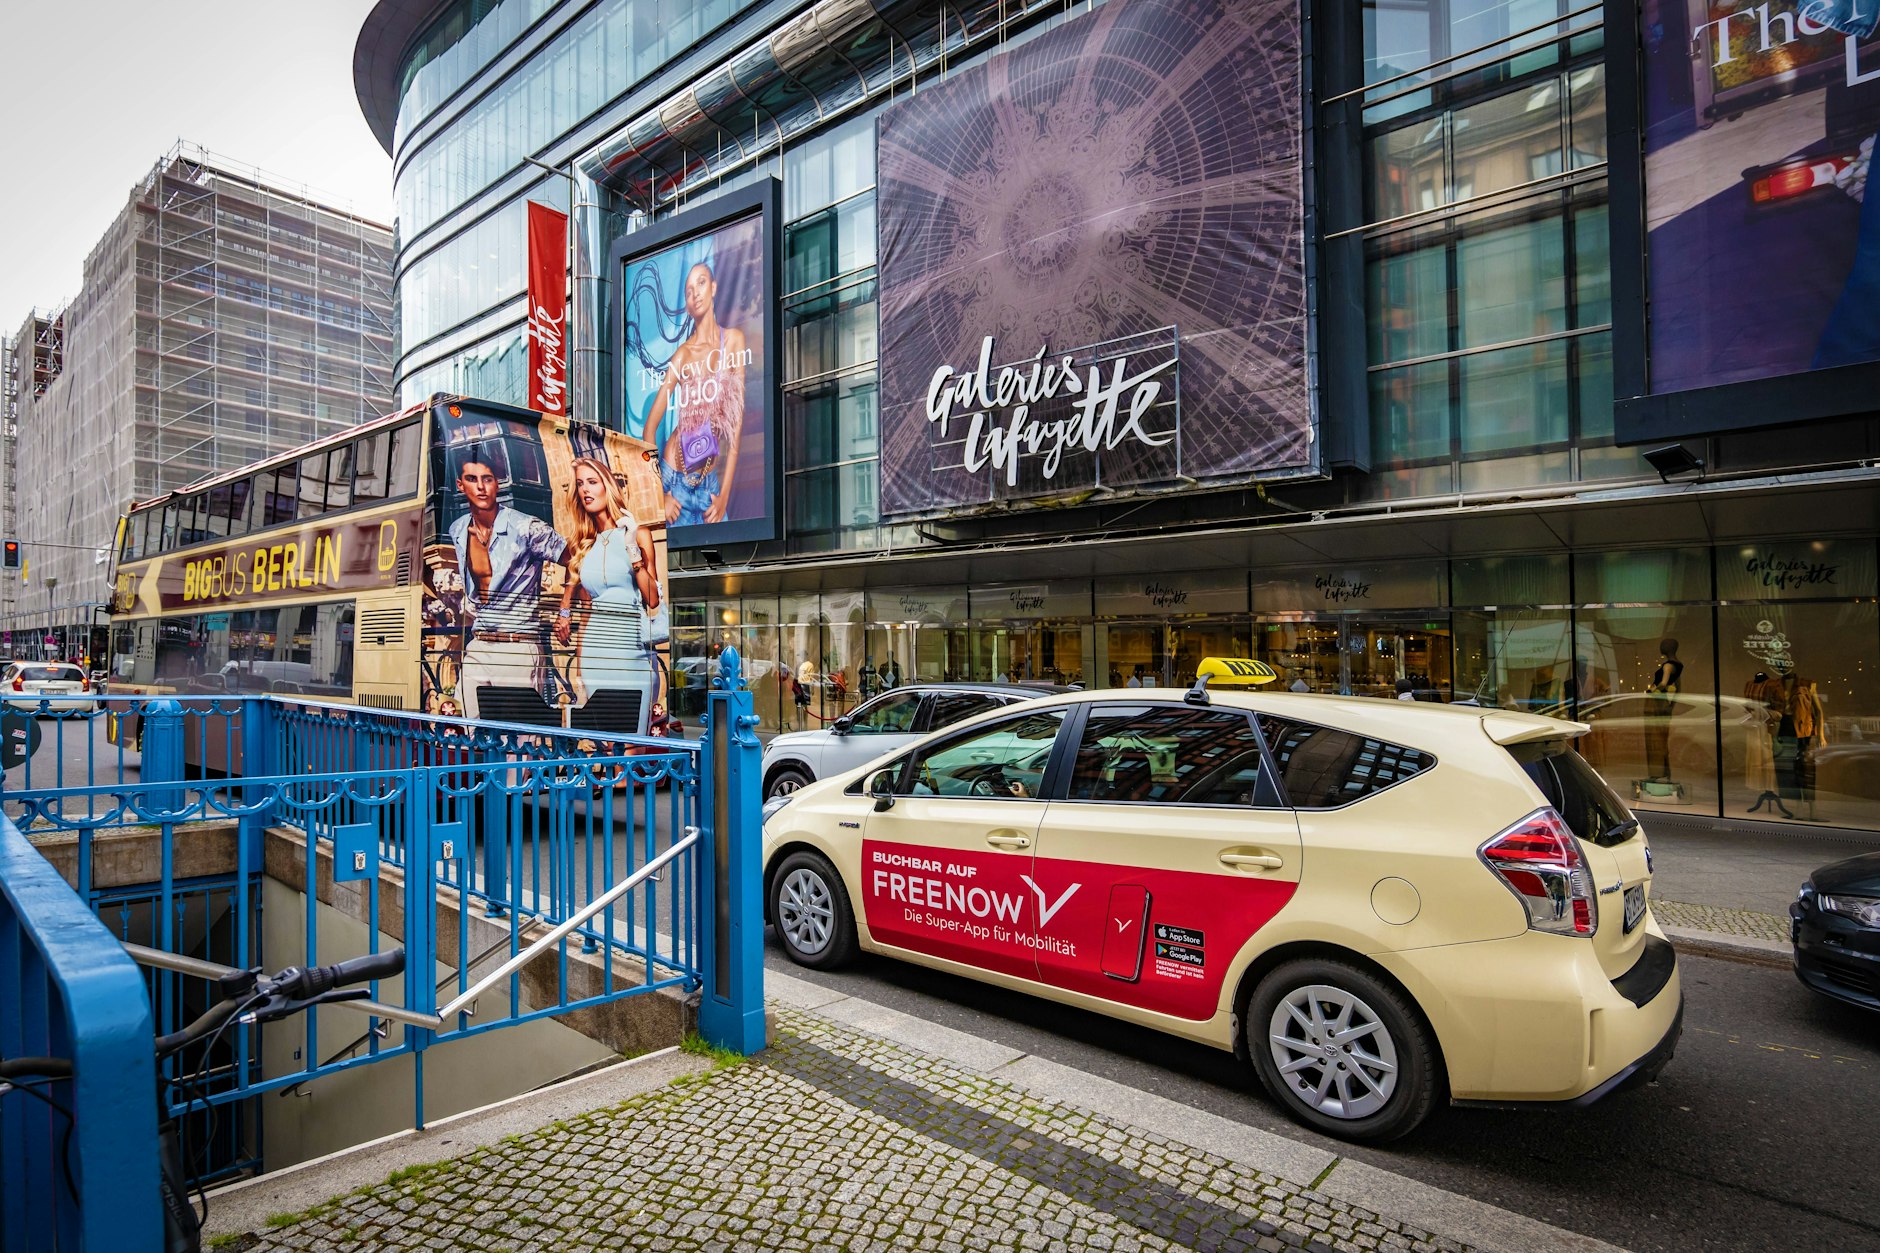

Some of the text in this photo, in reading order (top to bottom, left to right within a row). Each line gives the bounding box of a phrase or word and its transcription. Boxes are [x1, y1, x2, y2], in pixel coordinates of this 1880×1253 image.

[1691, 2, 1835, 68] The
[528, 295, 566, 411] Lafayette
[637, 347, 753, 391] The New Glam
[926, 336, 1083, 438] Galeries
[964, 357, 1179, 487] Lafayette
[252, 533, 342, 593] BERLIN
[1745, 553, 1809, 576] Galeries
[1762, 564, 1841, 590] Lafayette
[1225, 661, 1270, 675] TAXI
[872, 851, 977, 878] BUCHBAR AUF
[873, 869, 1024, 924] FREENOW
[904, 908, 1077, 957] Die Super-App für Mobilität
[1169, 932, 1201, 945] App Store
[1169, 951, 1202, 965] Google Play
